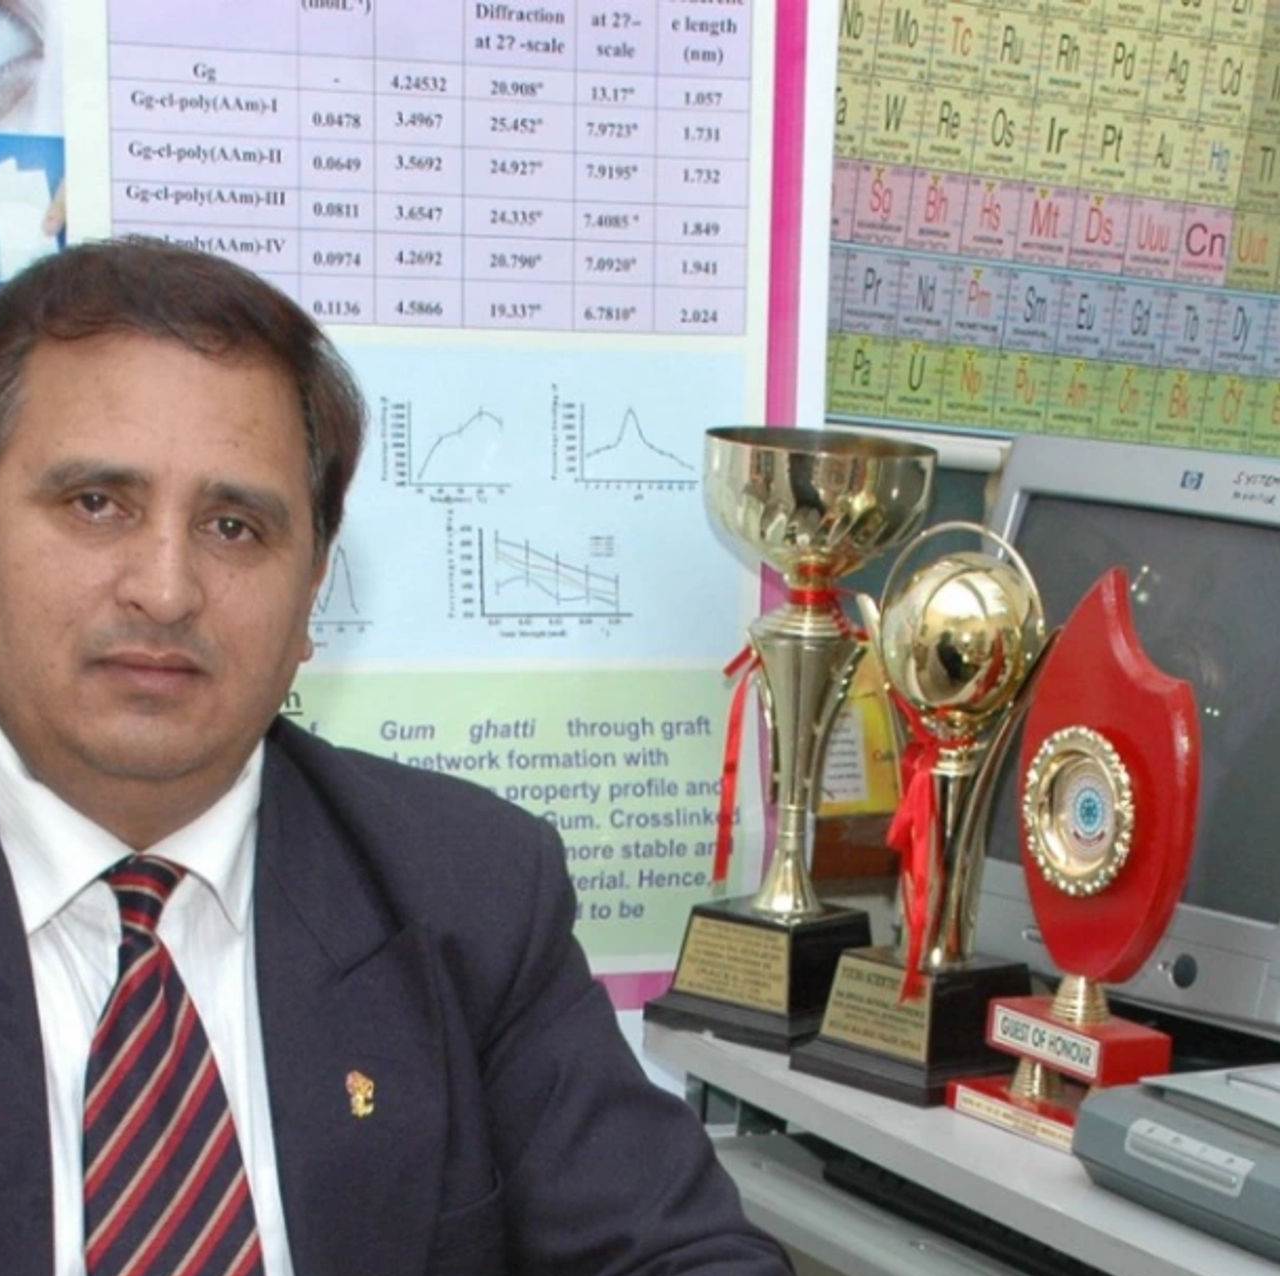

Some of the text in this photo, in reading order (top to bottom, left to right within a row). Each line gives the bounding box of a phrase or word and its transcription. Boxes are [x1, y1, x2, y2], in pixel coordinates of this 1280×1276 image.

[475, 2, 565, 25] Diffraction
[685, 16, 738, 37] length
[596, 42, 637, 59] scale
[683, 47, 725, 65] (nm)
[893, 7, 919, 49] Mo
[950, 15, 973, 57] Tc
[1111, 41, 1136, 82] Pd
[1219, 57, 1244, 97] Cd
[884, 93, 908, 132] W
[936, 100, 961, 141] Re
[990, 107, 1016, 150] Os
[1046, 115, 1070, 155] Ir
[1100, 123, 1124, 164] Pt
[1030, 199, 1061, 240] Mt
[1084, 207, 1114, 246] Ds
[1185, 222, 1227, 258] Cn
[380, 715, 712, 746] Gum ghatti through graft
[408, 748, 670, 771] network formation with
[505, 780, 602, 804] property
[609, 777, 680, 804] profile
[620, 839, 688, 861] stable
[693, 837, 734, 858] an
[569, 870, 631, 891] terial.
[589, 900, 645, 920] to be
[1032, 1025, 1047, 1047] OF
[1049, 1035, 1093, 1067] HONOUR
